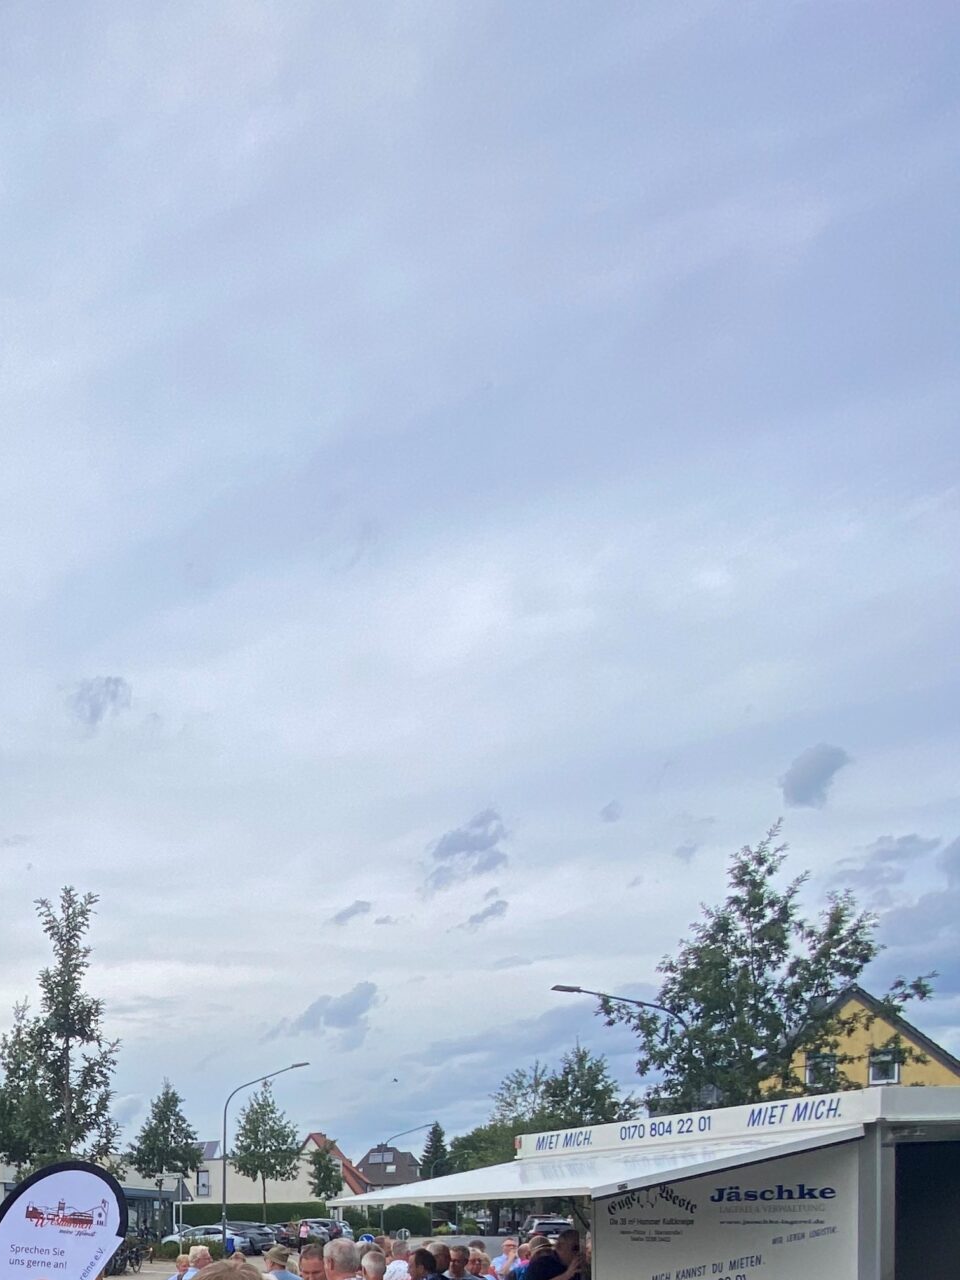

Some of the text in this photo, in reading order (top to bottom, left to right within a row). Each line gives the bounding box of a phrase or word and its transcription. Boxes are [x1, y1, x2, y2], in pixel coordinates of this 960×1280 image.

[536, 1097, 842, 1150] MIET MICH. 0170 804 22 01 MIET MICH.
[710, 1184, 836, 1202] Jäschke
[10, 1244, 65, 1256] Sprechen Sie
[9, 1258, 25, 1266] uns
[26, 1259, 51, 1269] gerne
[675, 1265, 707, 1280] KANNST
[712, 1262, 724, 1274] DU
[729, 1254, 766, 1271] MIETEN.
